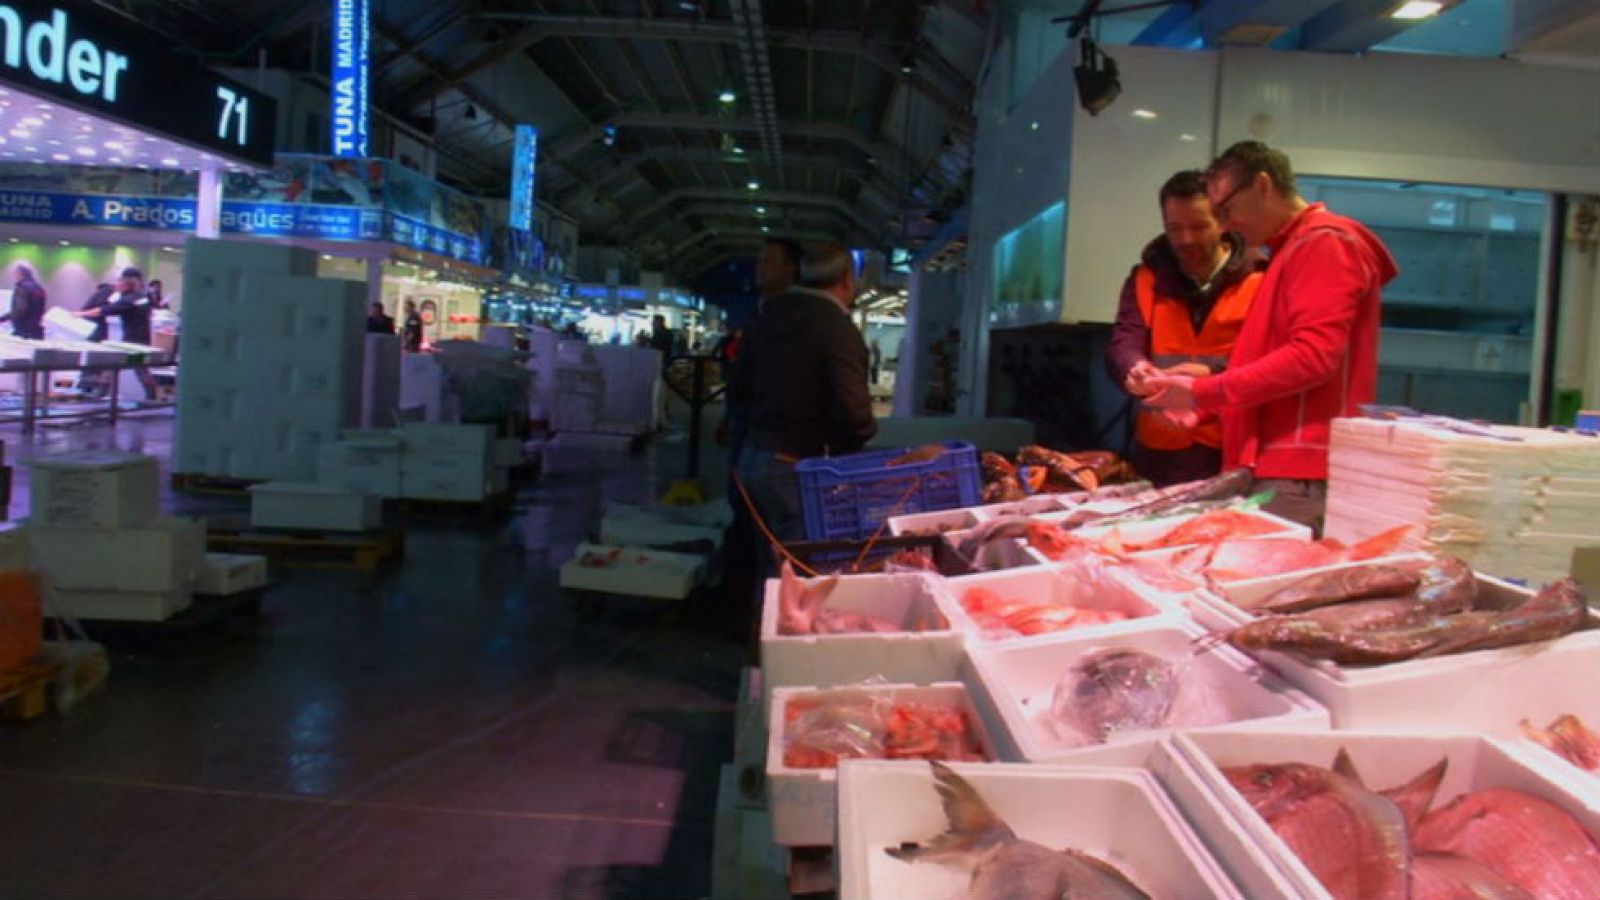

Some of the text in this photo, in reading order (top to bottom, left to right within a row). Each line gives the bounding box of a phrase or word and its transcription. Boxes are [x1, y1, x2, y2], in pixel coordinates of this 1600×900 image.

[0, 4, 129, 103] nder
[335, 0, 354, 156] TUNA MADRID
[216, 86, 249, 146] 71
[104, 199, 195, 225] Prados
[222, 208, 294, 232] agües
